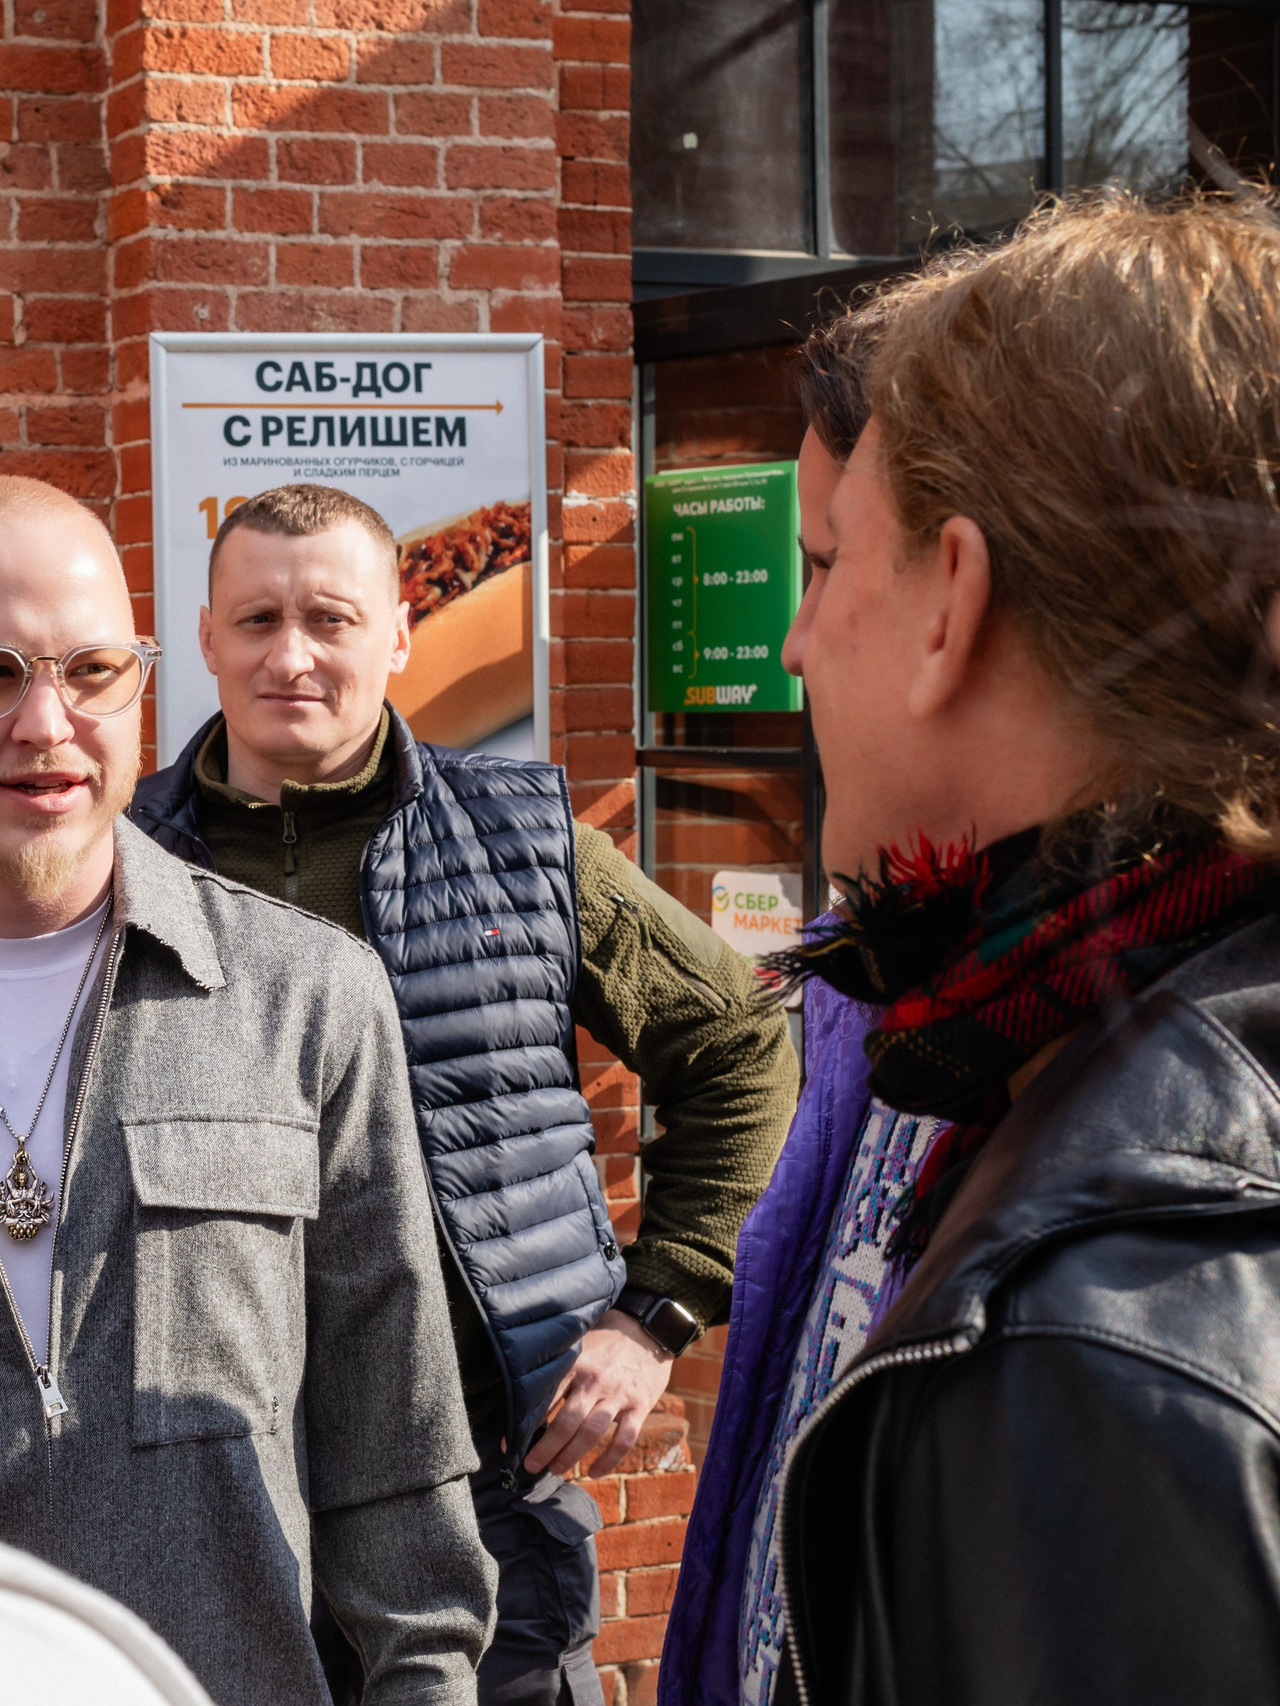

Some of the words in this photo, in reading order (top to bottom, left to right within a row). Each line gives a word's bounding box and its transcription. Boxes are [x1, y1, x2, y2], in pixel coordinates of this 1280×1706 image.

[254, 360, 432, 397] САБ-ДОГ
[222, 415, 251, 447] С
[262, 415, 467, 447] РЕЛИШЕМ
[223, 457, 237, 466] ИЗ
[240, 457, 330, 467] МАРИНОВАННЫХ
[400, 457, 408, 467] С
[410, 456, 465, 468] ГОРЧИЦЕЙ
[294, 469, 302, 477] И
[304, 468, 356, 478] СЛАДКИМ
[359, 468, 401, 478] ПЕРЦЕМ
[673, 500, 708, 517] ЧАСЫ
[710, 495, 766, 514] РАБОТЫ:
[703, 571, 728, 586] 8:00
[736, 569, 769, 584] 23:00
[704, 647, 729, 660] 9:00
[736, 645, 769, 659] 23:00
[684, 684, 757, 706] SUBWAY
[734, 892, 779, 911] СБЕР
